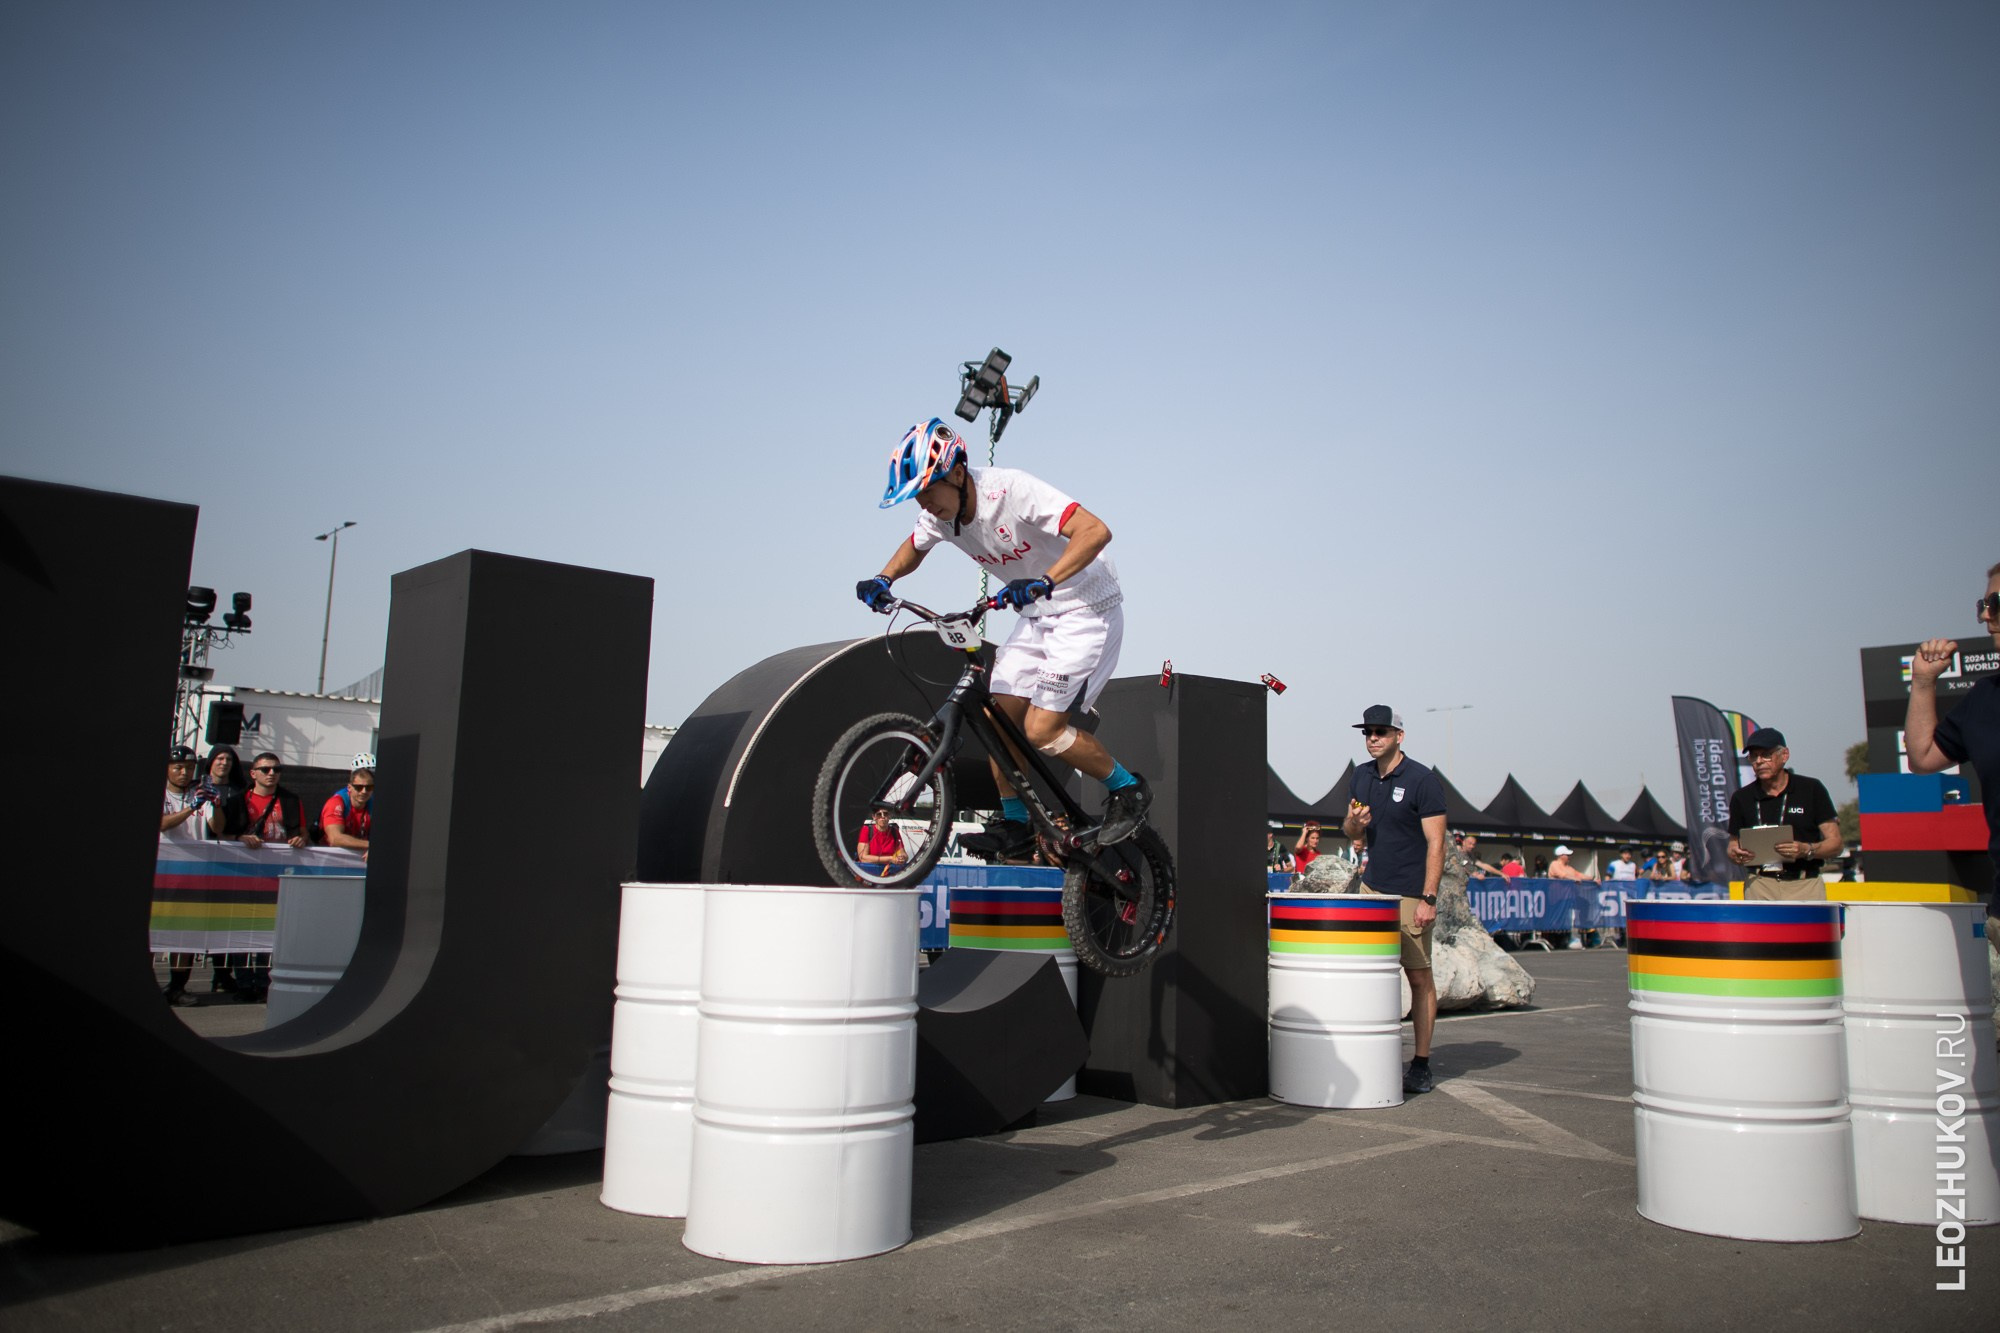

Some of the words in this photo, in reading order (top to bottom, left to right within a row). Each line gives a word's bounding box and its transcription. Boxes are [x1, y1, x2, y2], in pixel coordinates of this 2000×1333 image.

[971, 541, 1031, 566] AAN
[1964, 655, 1985, 664] 2024
[1964, 661, 2000, 673] WORLD
[1467, 890, 1545, 921] HIMANO
